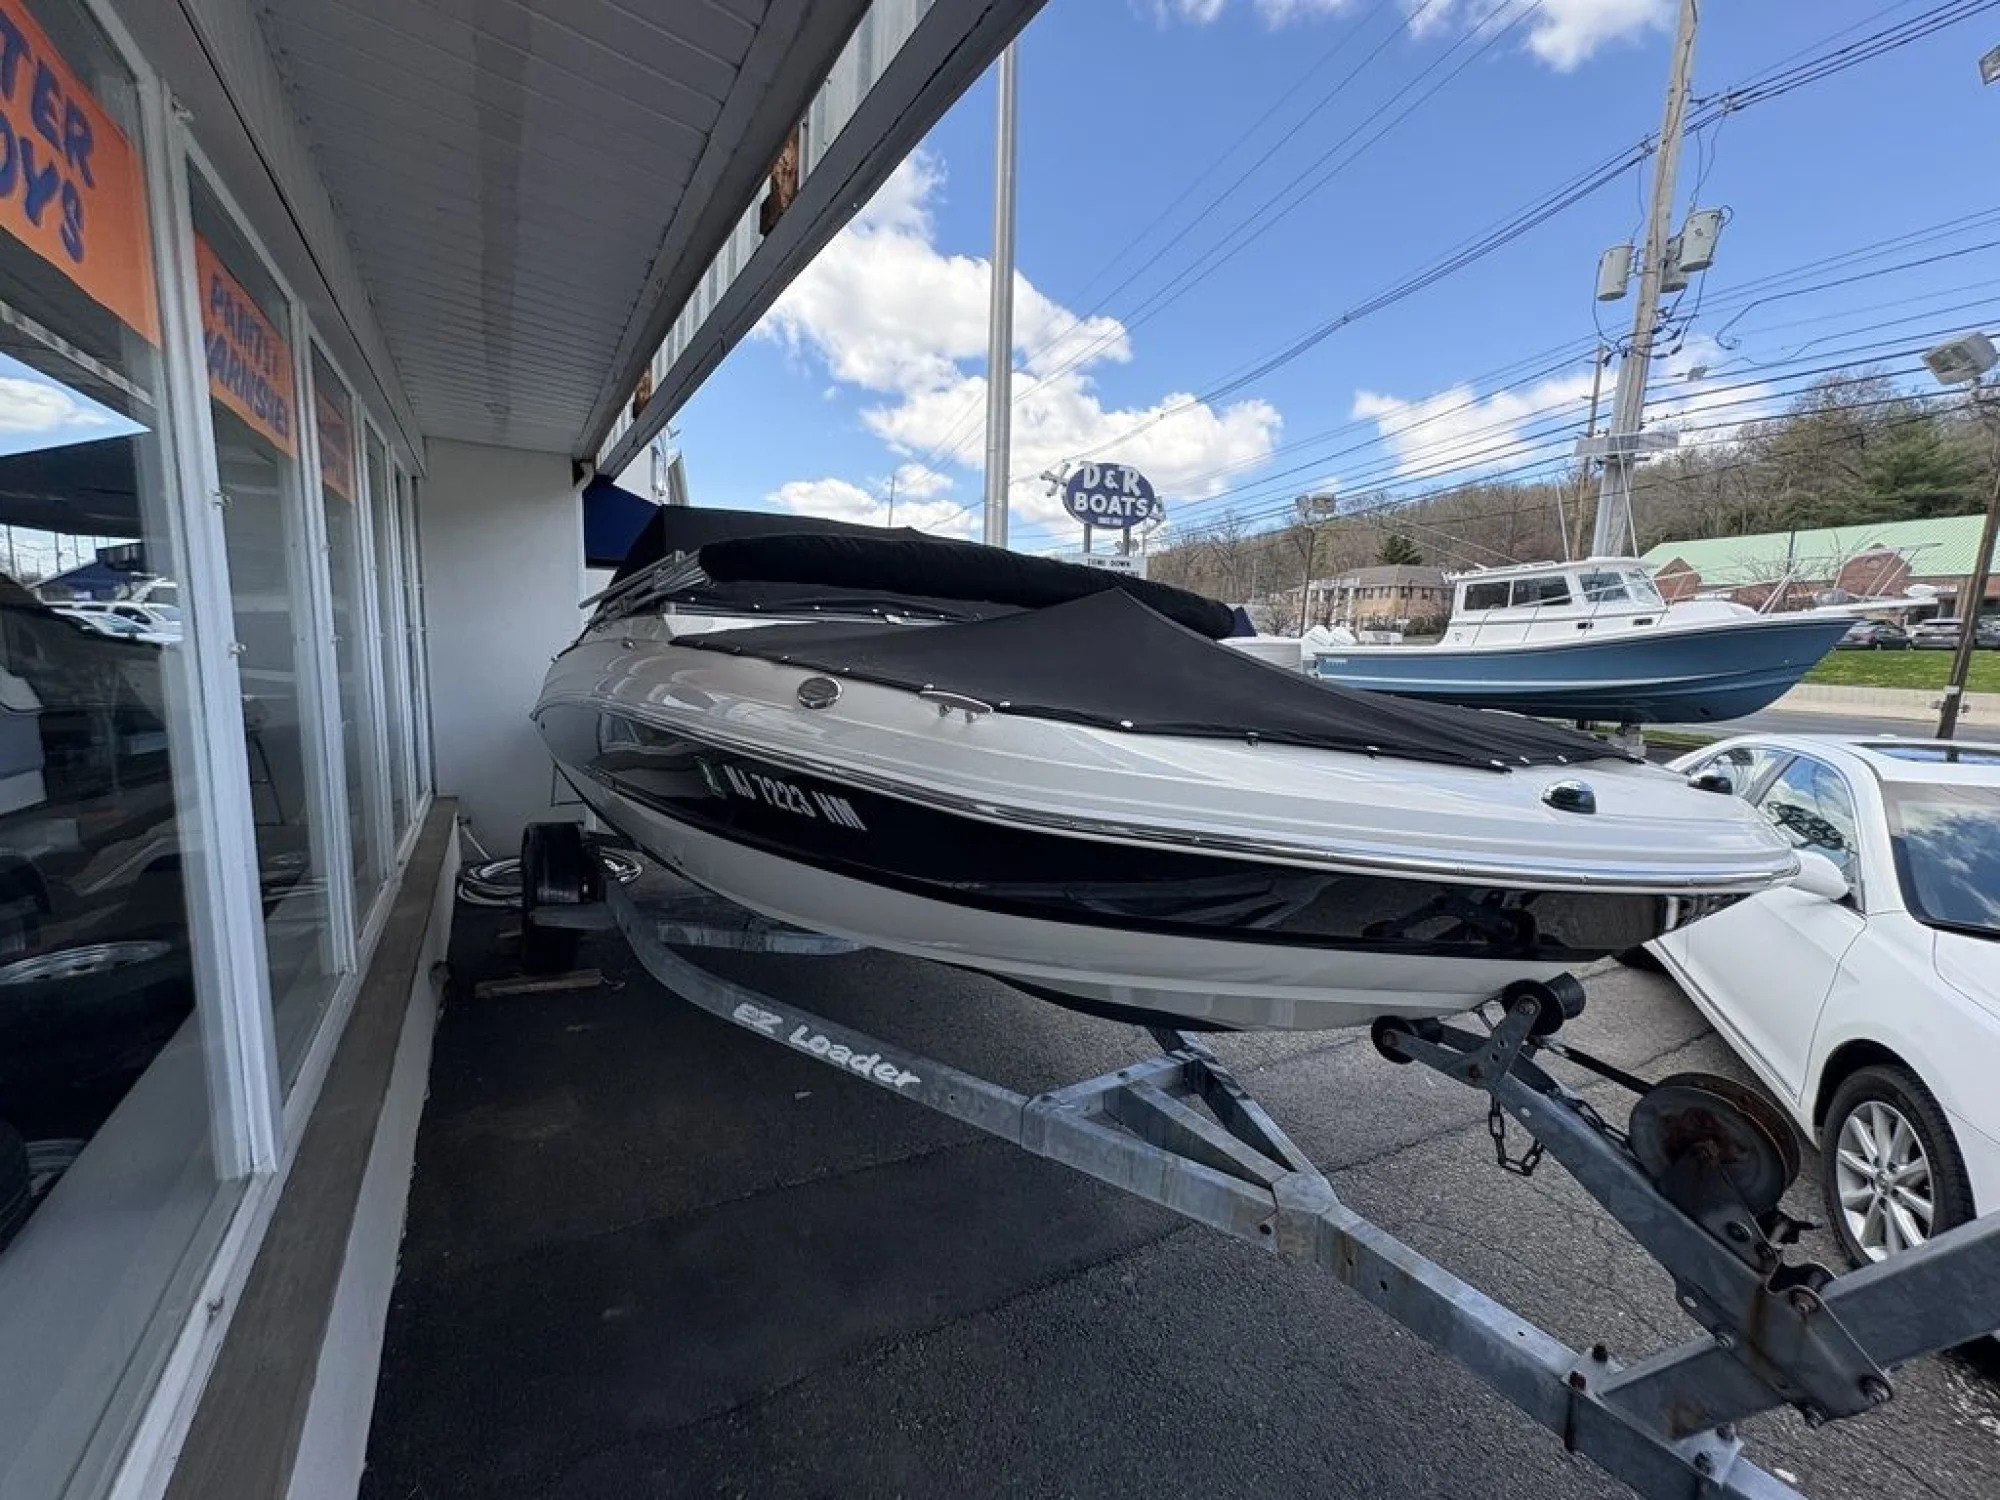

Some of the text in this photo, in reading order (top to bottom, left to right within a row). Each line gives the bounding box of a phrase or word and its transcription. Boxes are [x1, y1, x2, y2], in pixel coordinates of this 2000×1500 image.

[1080, 461, 1141, 497] D & R
[1074, 491, 1149, 517] BOATS
[751, 774, 817, 818] 7223
[732, 1003, 922, 1087] EZ Loader
